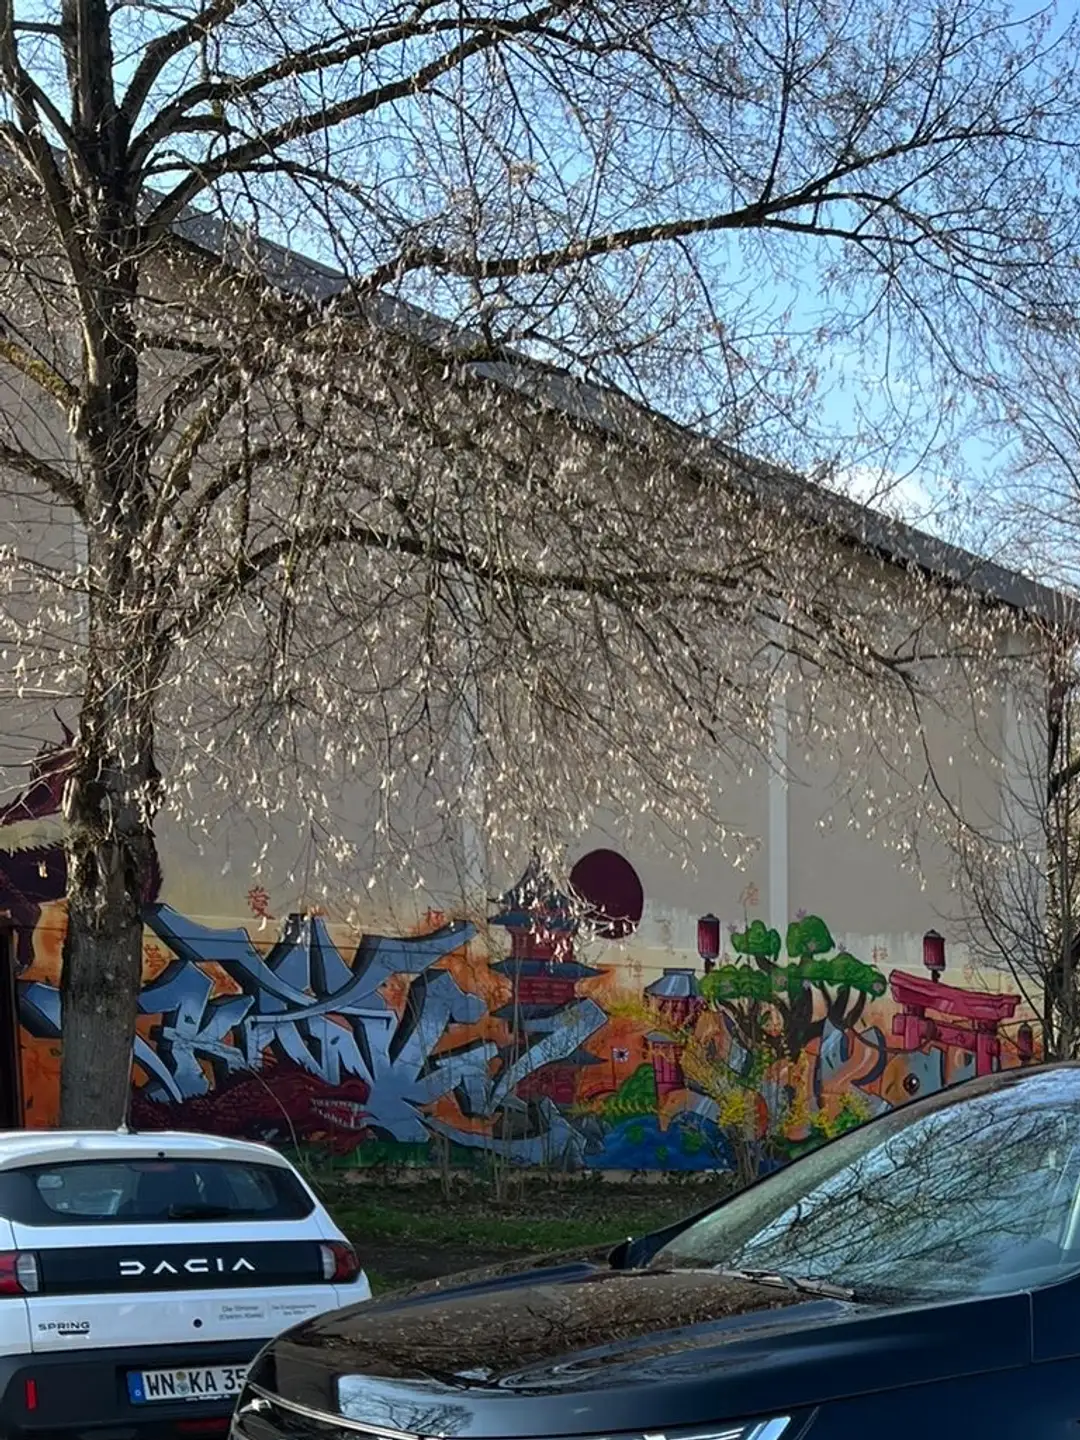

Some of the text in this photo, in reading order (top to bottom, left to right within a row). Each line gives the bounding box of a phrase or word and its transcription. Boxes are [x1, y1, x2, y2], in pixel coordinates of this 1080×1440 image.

[119, 1258, 256, 1276] DACIA
[38, 1320, 91, 1332] SPRING
[145, 1373, 176, 1396] WN
[188, 1371, 218, 1393] KA
